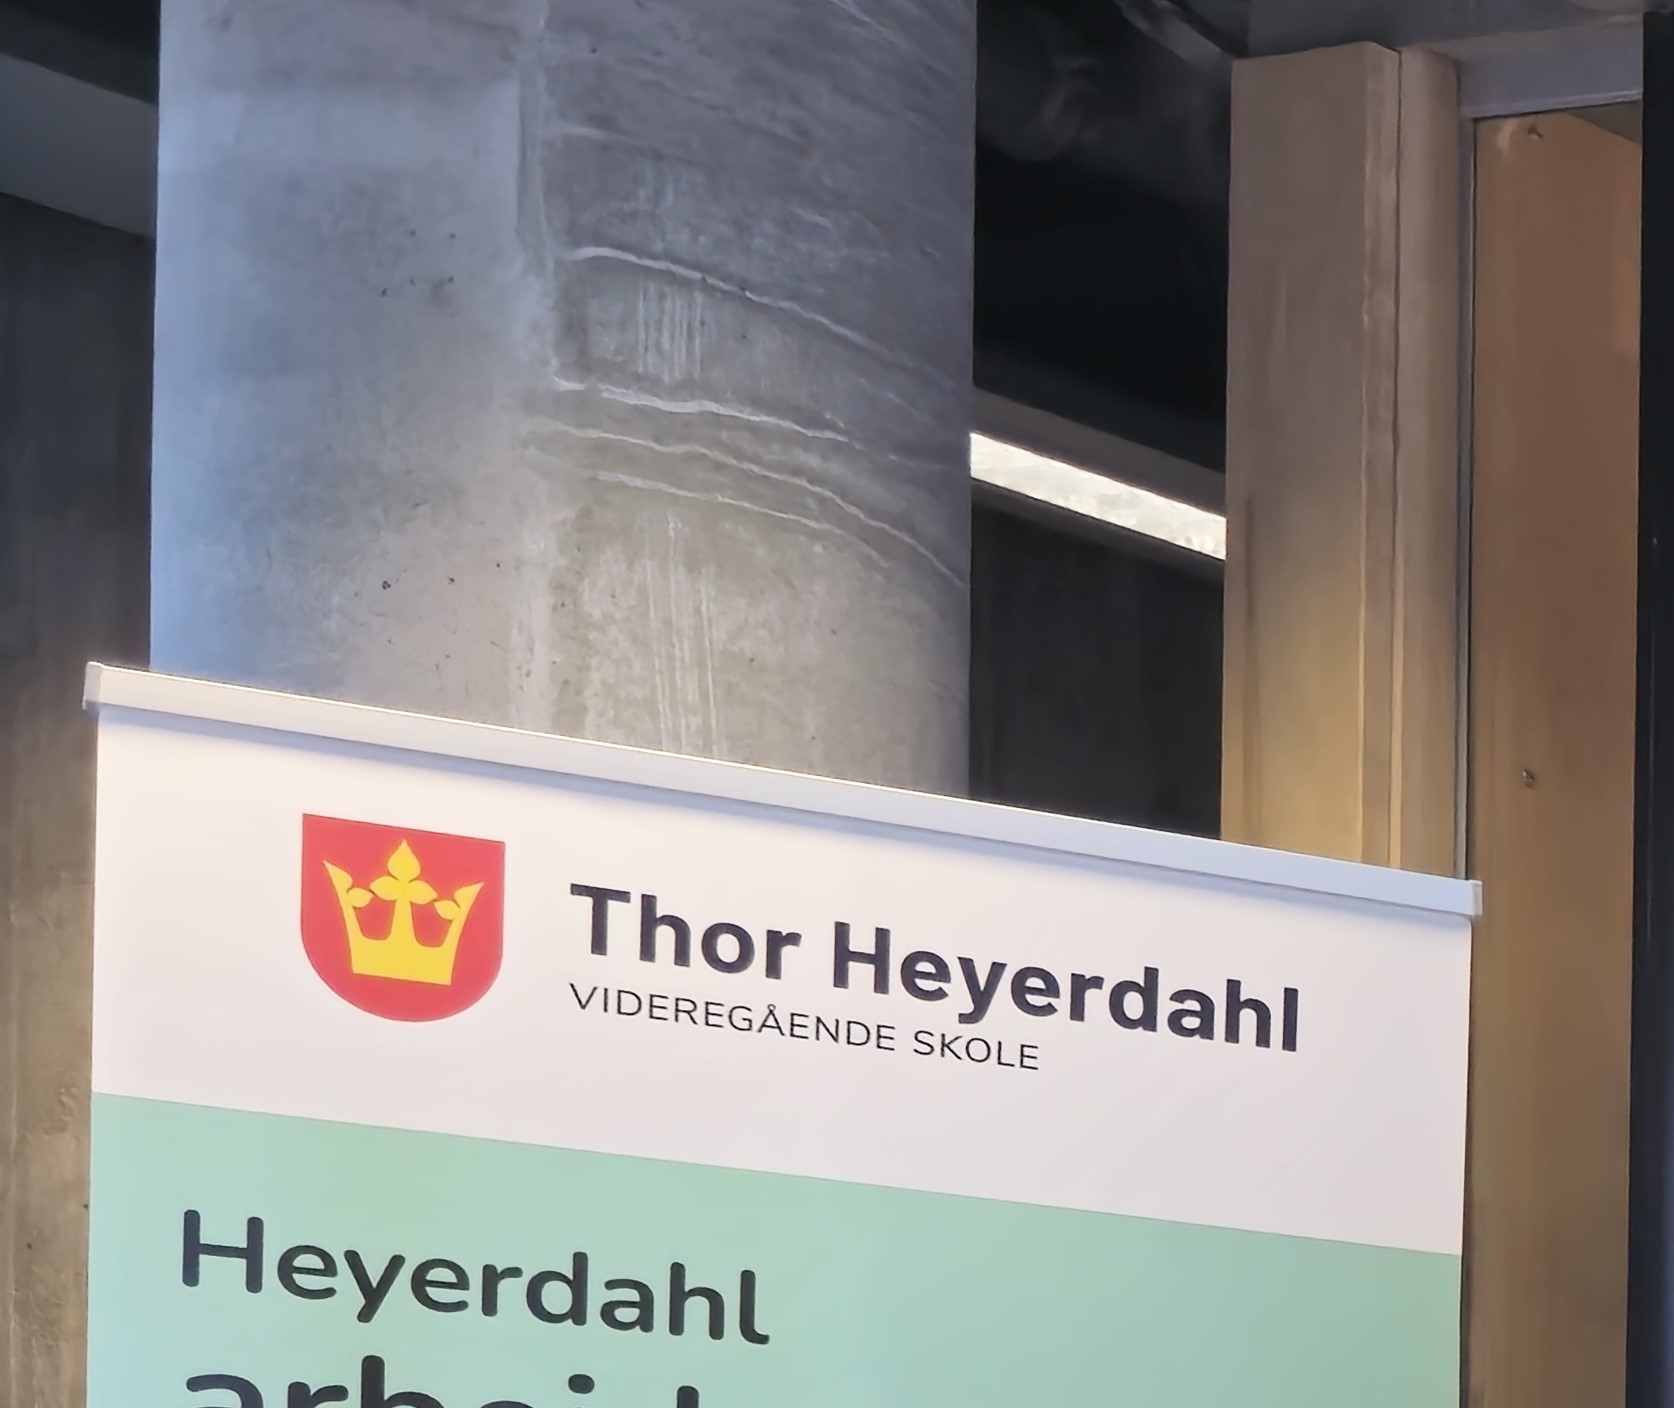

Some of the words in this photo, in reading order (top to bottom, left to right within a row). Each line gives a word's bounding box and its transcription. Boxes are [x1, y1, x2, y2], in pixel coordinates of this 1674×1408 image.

[569, 882, 803, 984] Thor
[826, 920, 1300, 1053] Heyerdahl
[569, 982, 896, 1052] VIDEREGÅENDE
[913, 1026, 1040, 1072] SKOLE
[181, 1209, 770, 1346] Heyerdahl
